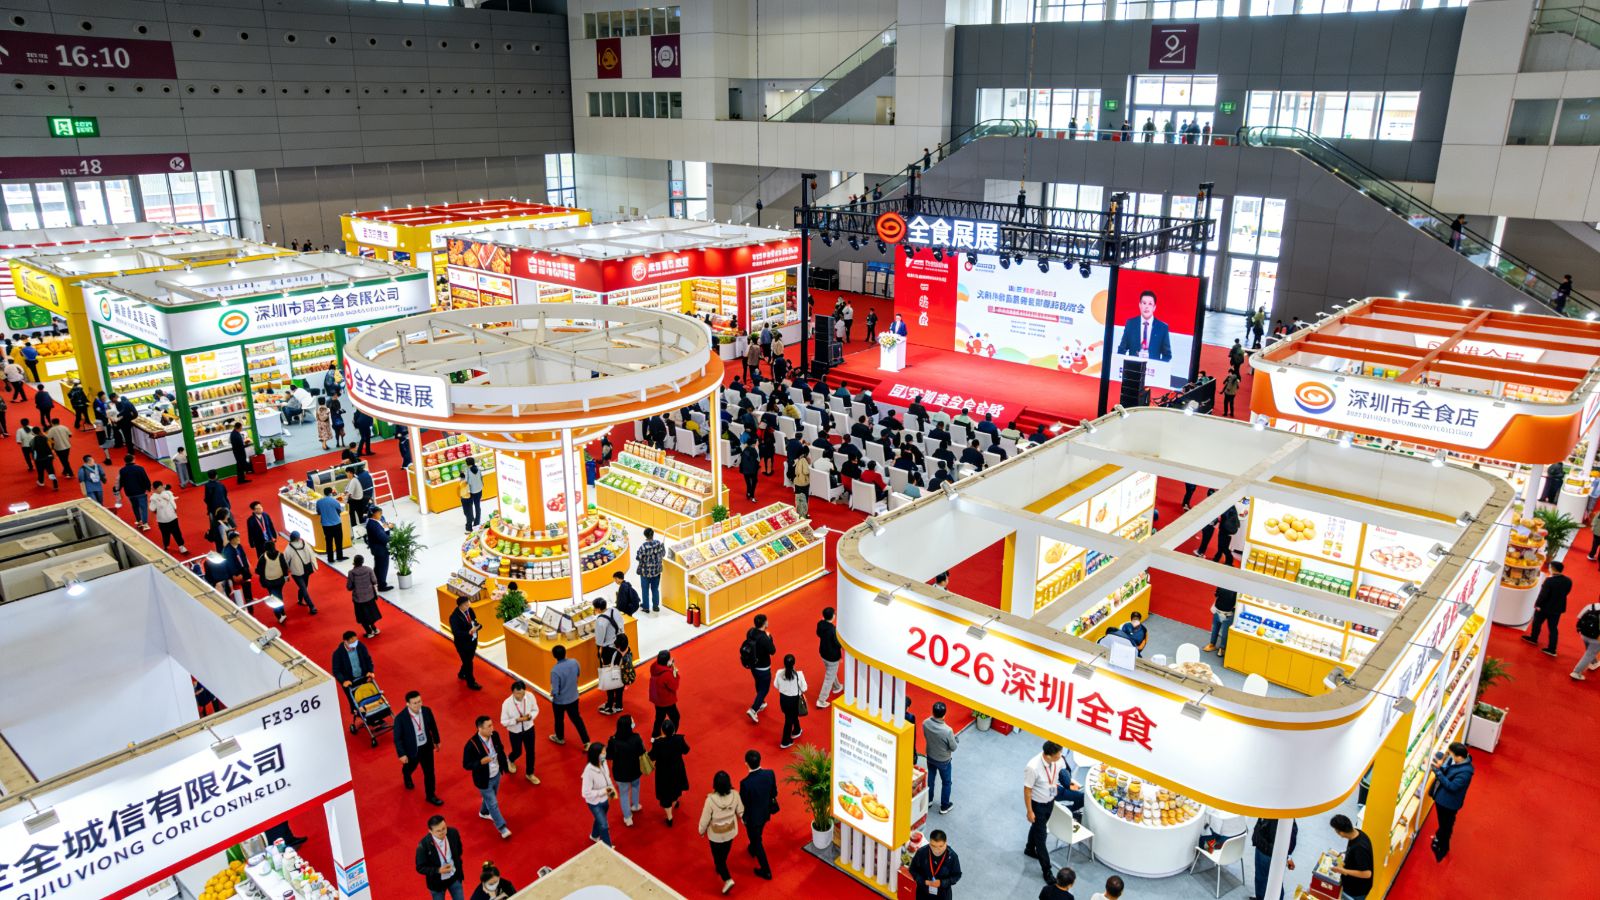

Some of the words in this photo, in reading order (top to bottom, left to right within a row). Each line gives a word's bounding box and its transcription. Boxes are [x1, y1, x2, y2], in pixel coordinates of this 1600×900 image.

[55, 44, 130, 69] 16:10
[908, 215, 998, 251] 全食展展
[1347, 388, 1479, 428] 深圳市全食店
[906, 626, 995, 686] 2026
[1001, 658, 1158, 752] 深圳全食
